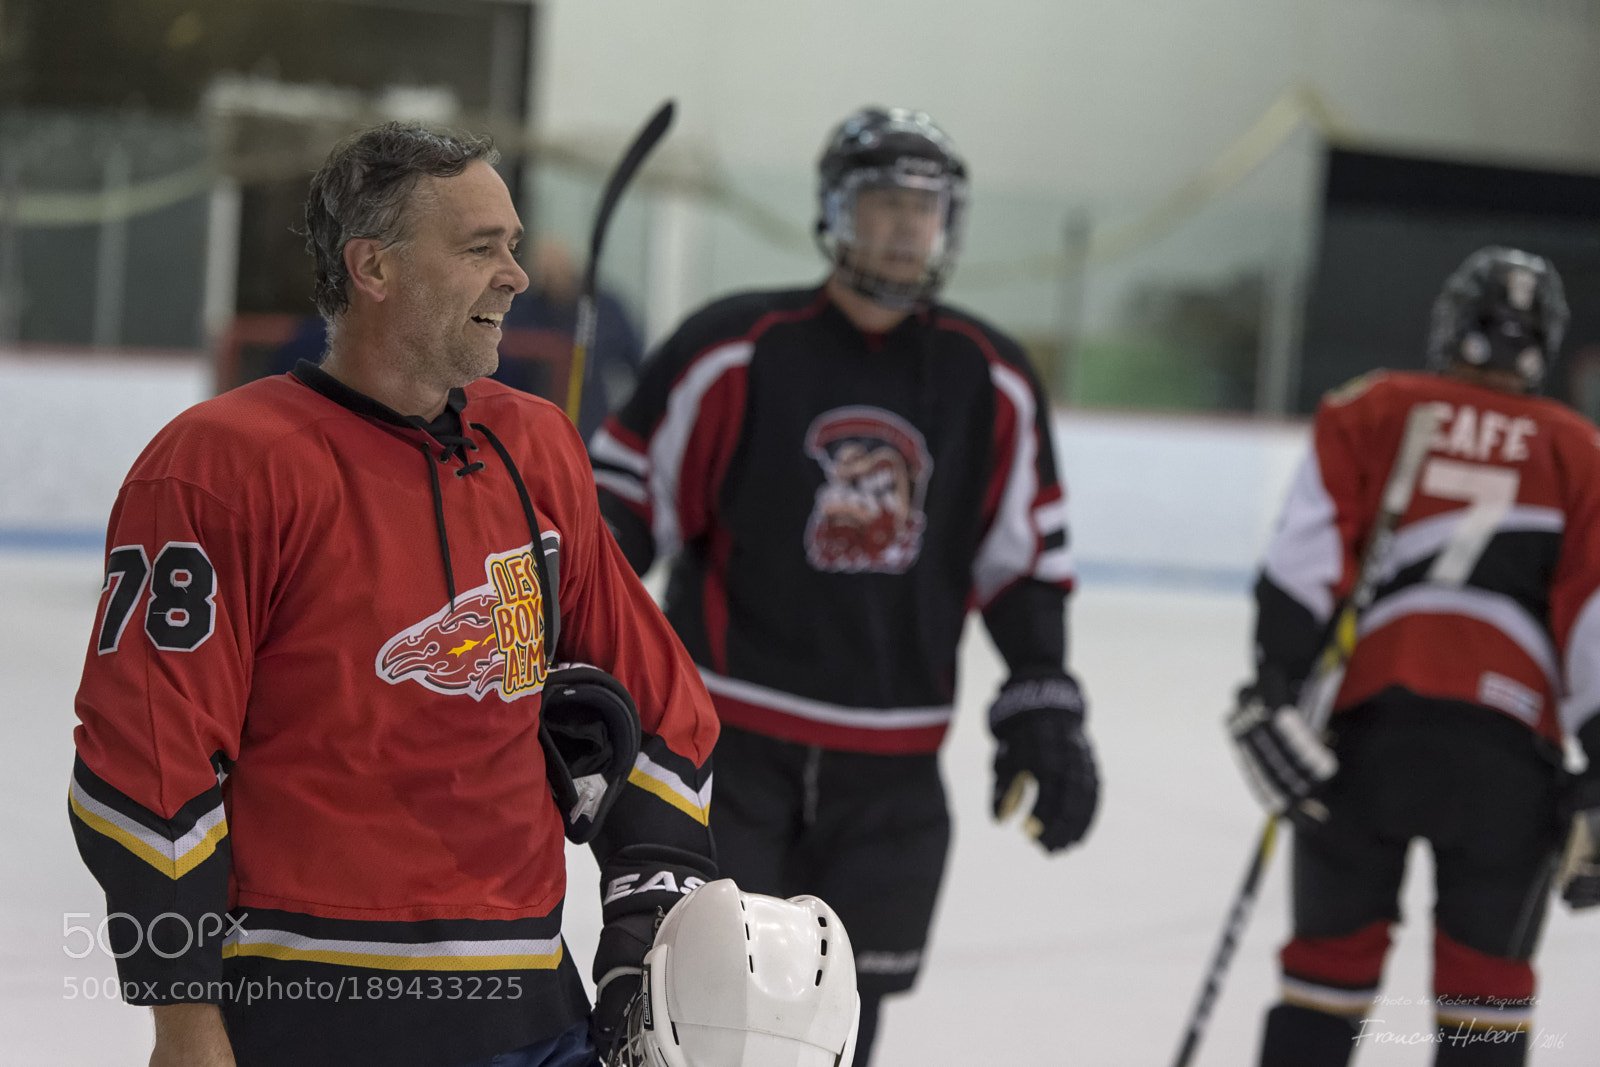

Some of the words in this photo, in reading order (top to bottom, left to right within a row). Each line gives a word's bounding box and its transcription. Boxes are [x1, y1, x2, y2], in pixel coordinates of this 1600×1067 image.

[1422, 456, 1521, 588] 7
[98, 541, 217, 656] 78
[493, 555, 540, 606] LES
[495, 596, 545, 651] BOY
